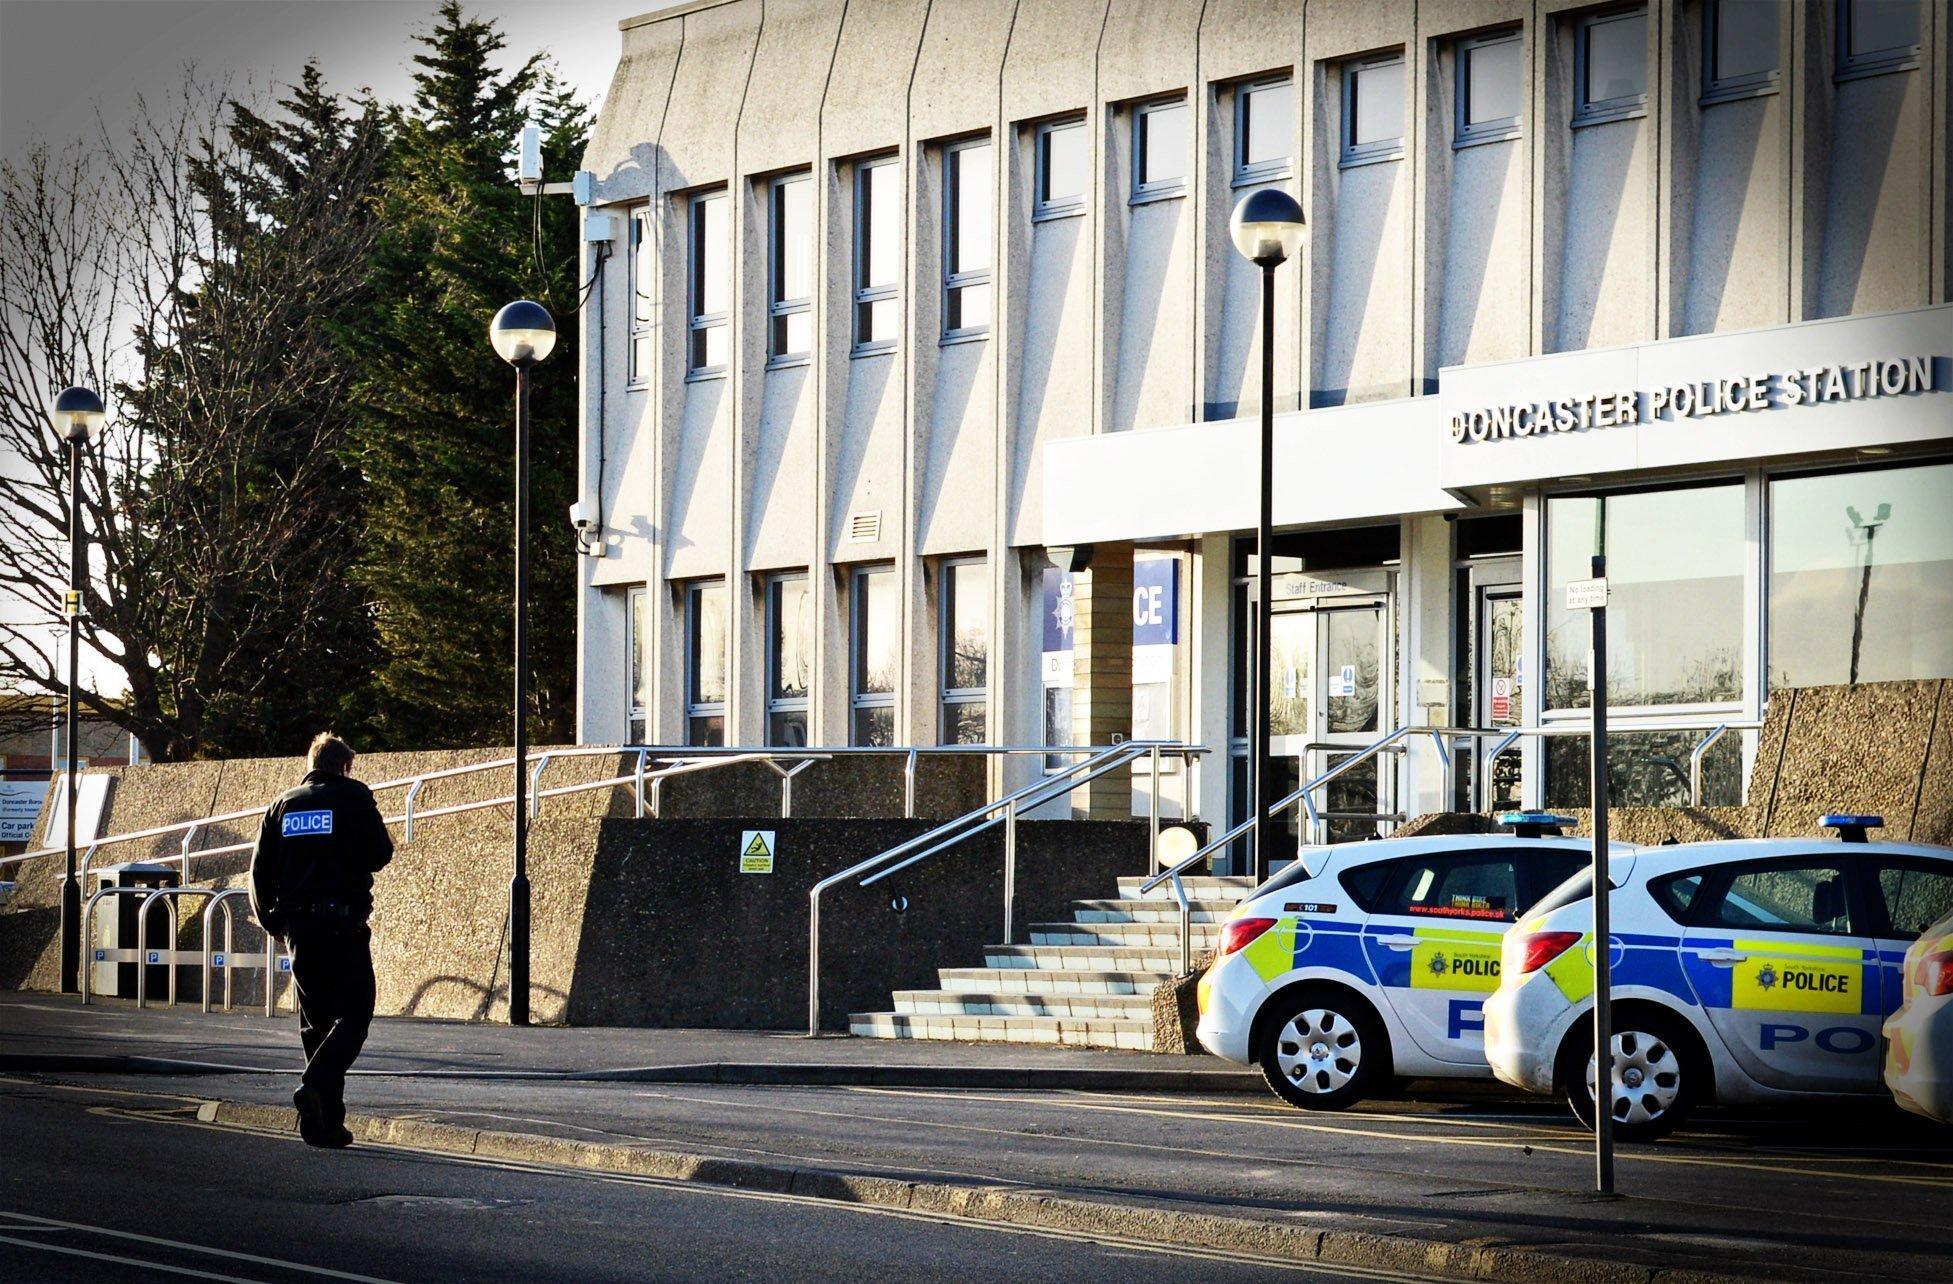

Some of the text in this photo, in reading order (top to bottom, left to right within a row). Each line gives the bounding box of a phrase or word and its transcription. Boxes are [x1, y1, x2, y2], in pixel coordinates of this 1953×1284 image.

[1450, 355, 1933, 443] DONCASTER POLICE STATION
[1287, 581, 1347, 594] Staff Entrance
[1581, 584, 1605, 594] loading
[1569, 594, 1605, 605] at any time
[1133, 586, 1163, 626] CE
[1, 822, 15, 830] Car
[283, 814, 331, 832] POLICE
[1304, 904, 1318, 912] 101
[97, 951, 104, 960] P
[150, 953, 158, 962] P
[215, 955, 223, 965] P
[282, 960, 290, 969] P
[1782, 971, 1849, 993] POLICE
[1760, 1023, 1875, 1054] PO
